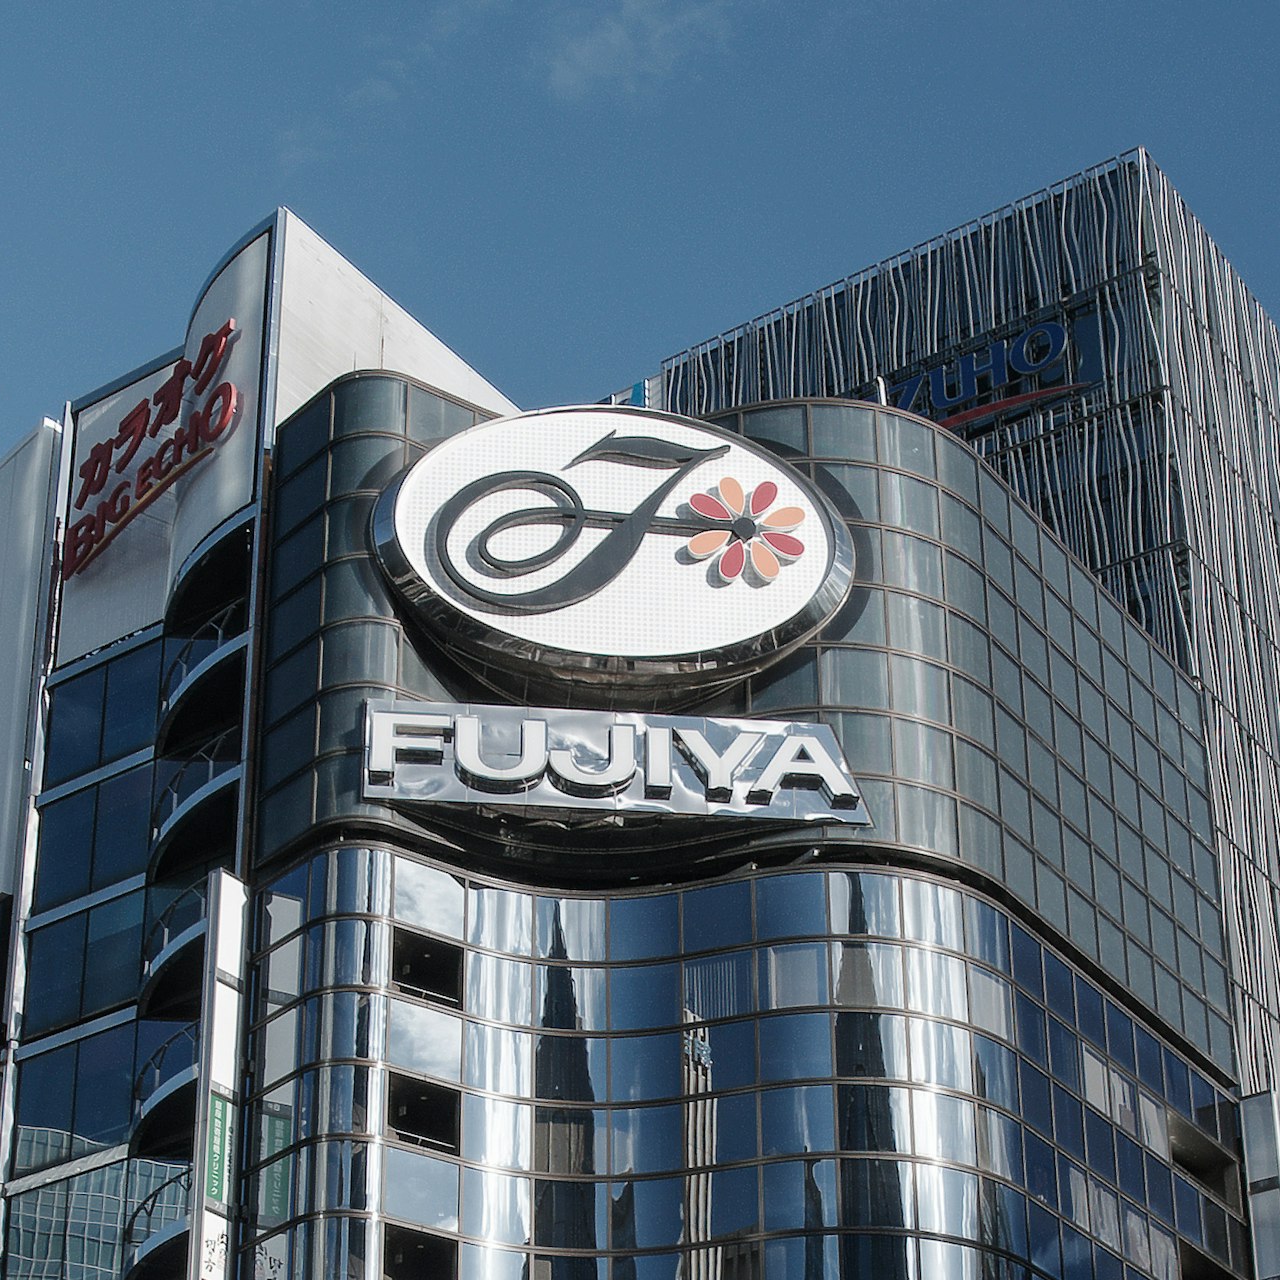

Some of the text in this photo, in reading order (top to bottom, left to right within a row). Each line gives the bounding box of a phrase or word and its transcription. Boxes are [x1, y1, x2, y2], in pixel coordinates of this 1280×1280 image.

[75, 318, 236, 509] カラオケ
[887, 322, 1068, 413] ZUHO
[64, 382, 236, 580] BIG ECHO
[368, 711, 859, 809] FUJIYA
